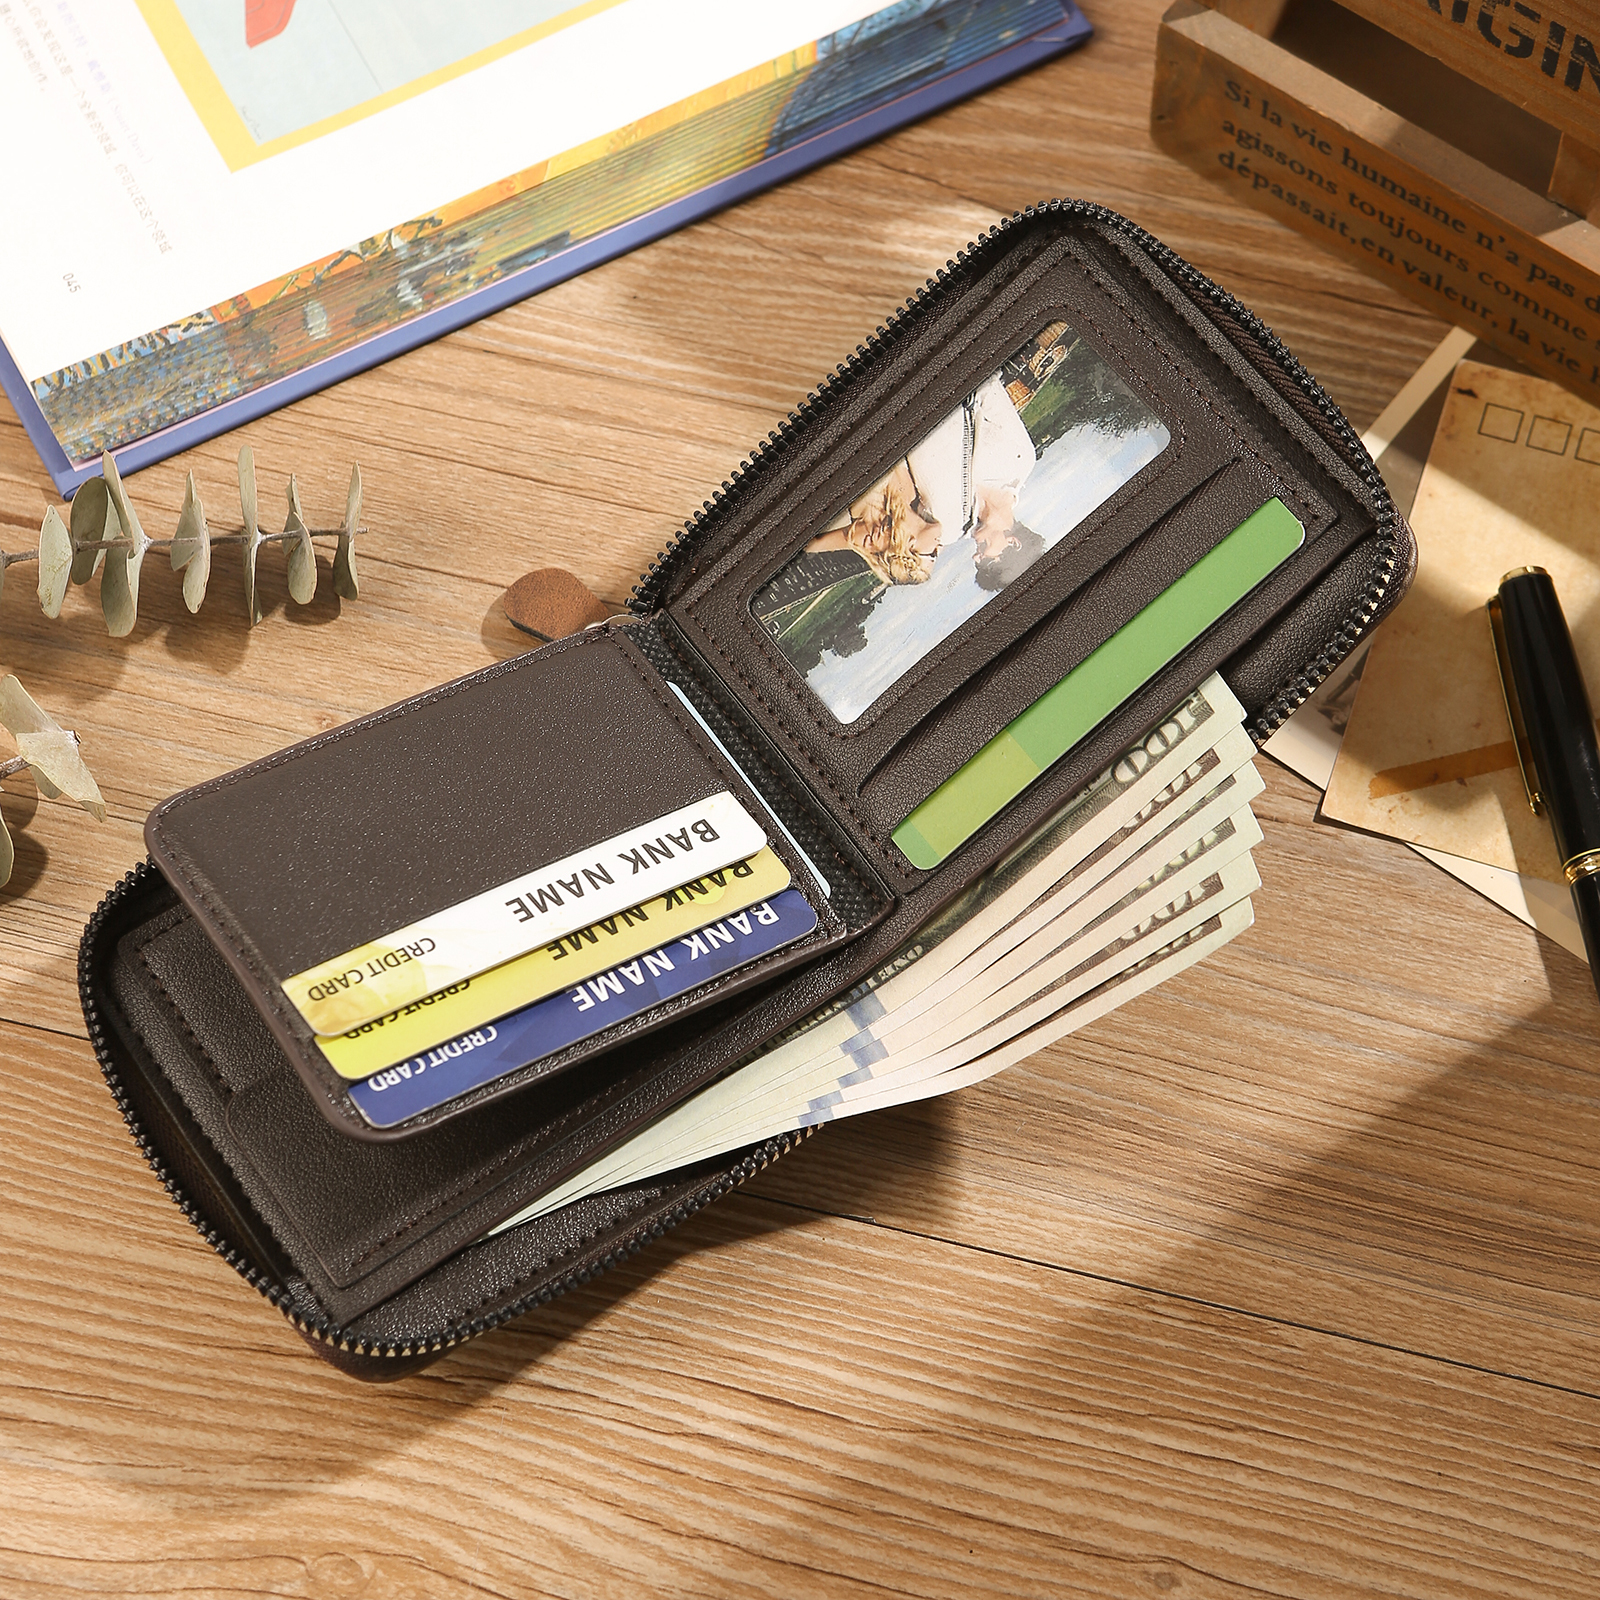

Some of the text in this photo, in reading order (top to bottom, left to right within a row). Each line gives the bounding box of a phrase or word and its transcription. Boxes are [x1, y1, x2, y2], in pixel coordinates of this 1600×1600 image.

[1222, 120, 1588, 341] agissons toujours comme
[1225, 80, 1251, 109] Si
[1260, 100, 1283, 128] la
[1291, 122, 1332, 156] vie
[1342, 147, 1466, 234] humaine
[1526, 263, 1576, 298] pas
[62, 272, 81, 293] 045
[1402, 258, 1498, 328] valeur,
[1508, 317, 1530, 345] la
[1540, 340, 1581, 373] vie
[1111, 699, 1198, 784] 100
[505, 818, 720, 923] BANK NAME
[308, 937, 436, 1001] CREDIT CARD
[566, 901, 780, 1012] BANK NAME
[367, 1025, 498, 1092] CREDIT CARD
